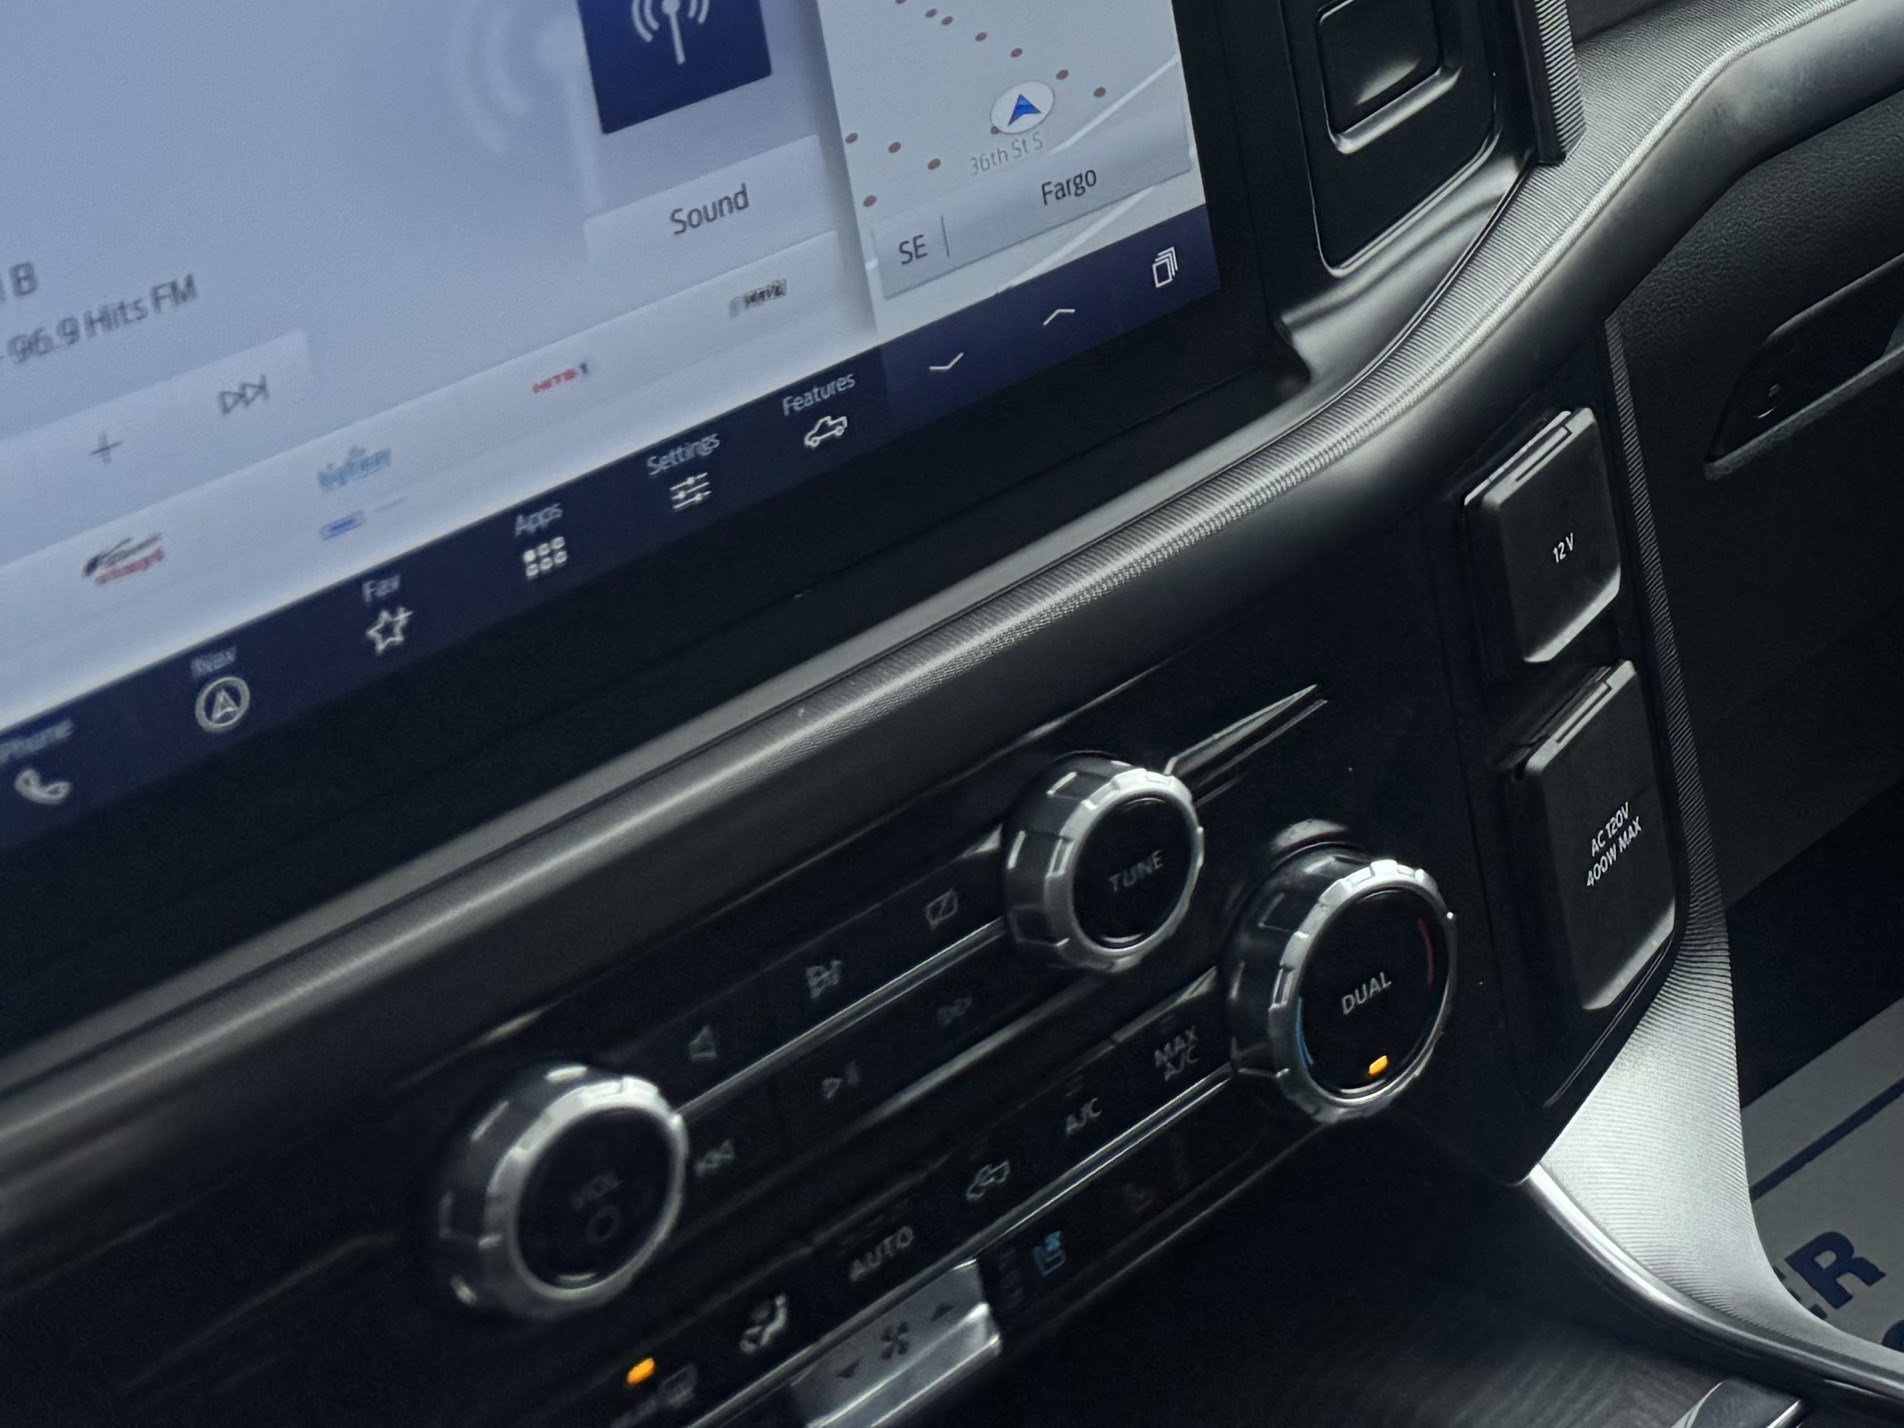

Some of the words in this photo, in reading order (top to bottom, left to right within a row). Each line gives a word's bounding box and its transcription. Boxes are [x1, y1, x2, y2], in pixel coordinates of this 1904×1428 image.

[969, 147, 1009, 176] 36th
[1011, 138, 1030, 159] St
[1032, 130, 1044, 150] S
[669, 182, 750, 236] Sound
[1040, 166, 1098, 207] Fargo
[898, 234, 928, 265] SE
[84, 298, 148, 339] Hits
[150, 273, 199, 314] FM
[782, 372, 856, 416] Features
[646, 431, 721, 477] Settings
[514, 500, 563, 536] Apps
[1586, 846, 1617, 887] 400W
[1618, 815, 1642, 853] MAX
[1590, 829, 1606, 857] AC
[1605, 801, 1630, 836] 120V
[1107, 849, 1165, 894] TUNE
[1340, 970, 1393, 1017] DUAL
[1154, 1025, 1199, 1068] MAX
[1065, 1097, 1102, 1137] A/C
[849, 1225, 915, 1282] AUTO
